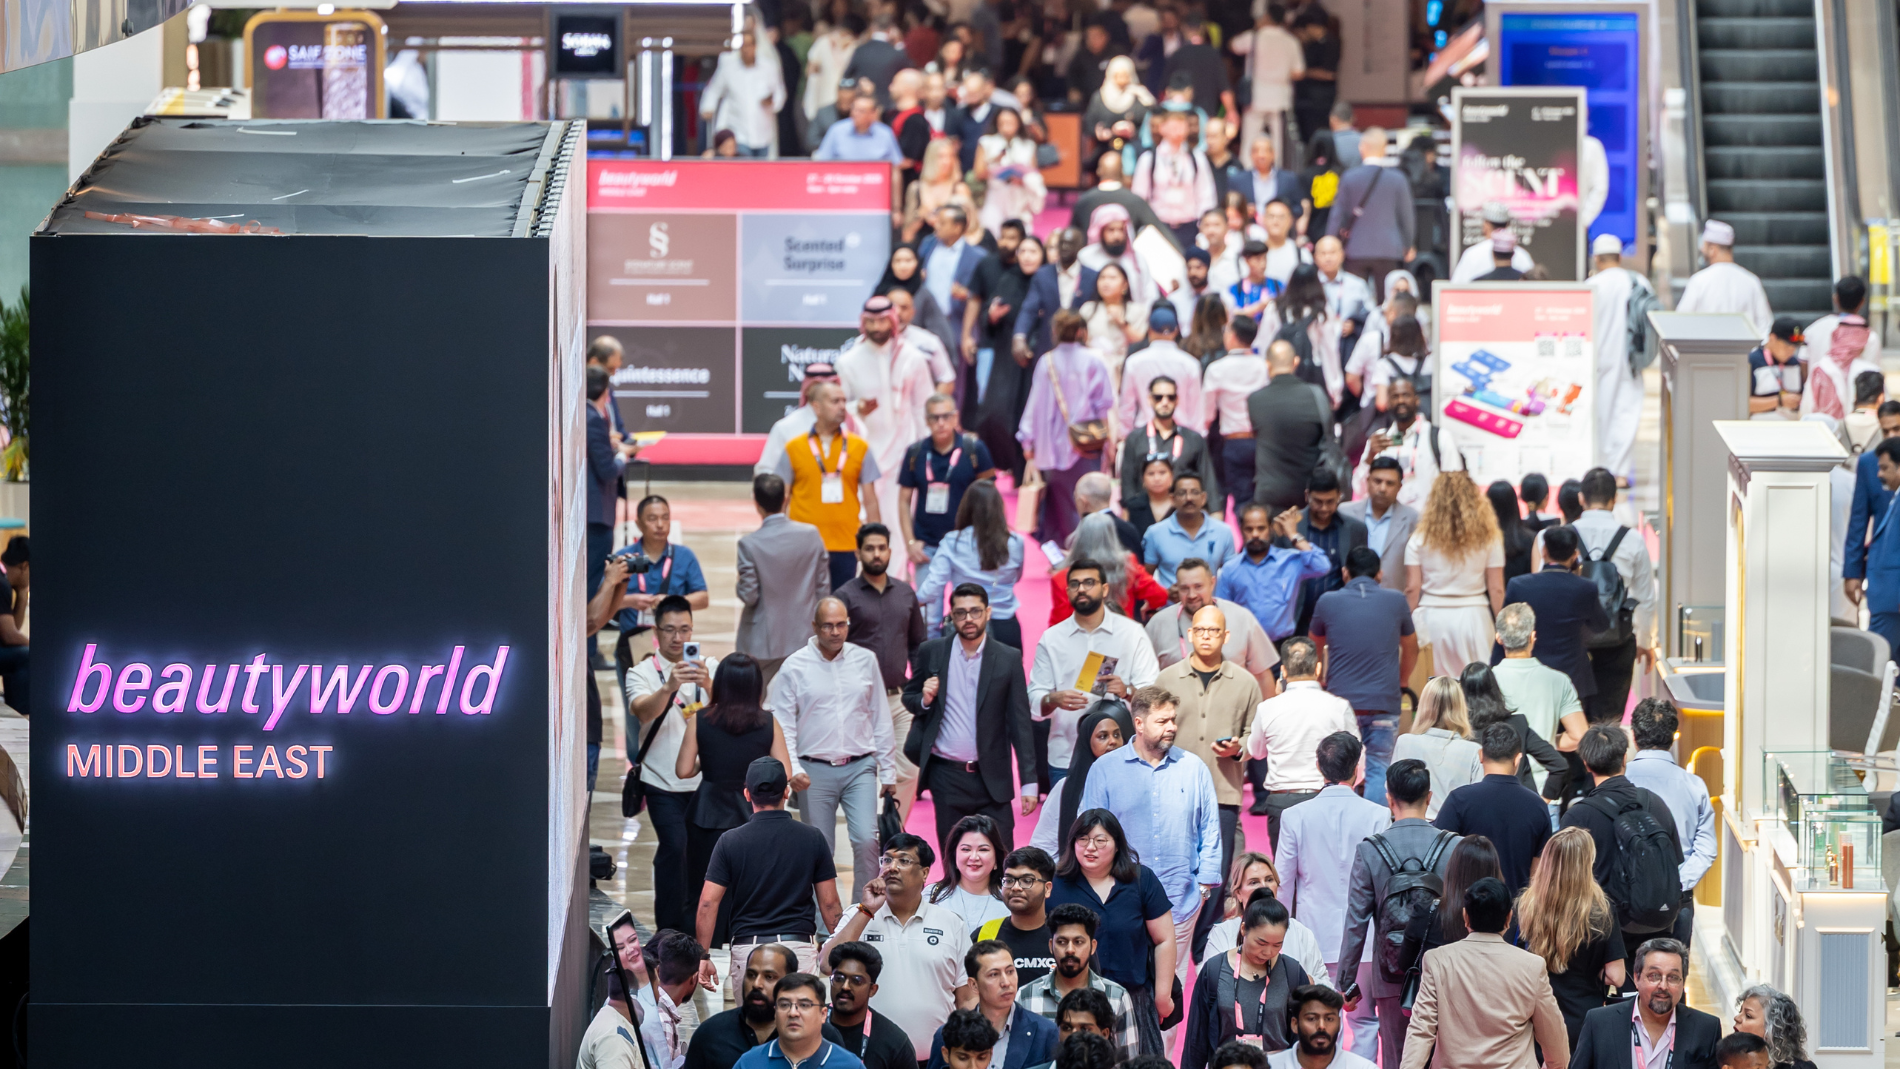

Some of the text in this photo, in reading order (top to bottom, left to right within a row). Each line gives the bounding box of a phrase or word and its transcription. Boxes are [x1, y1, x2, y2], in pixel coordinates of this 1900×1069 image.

[288, 44, 367, 61] SAIF ZONE
[784, 237, 844, 253] Scented
[784, 255, 845, 273] Surprise
[67, 643, 509, 731] beautyworld
[67, 745, 333, 779] MIDDLE EAST
